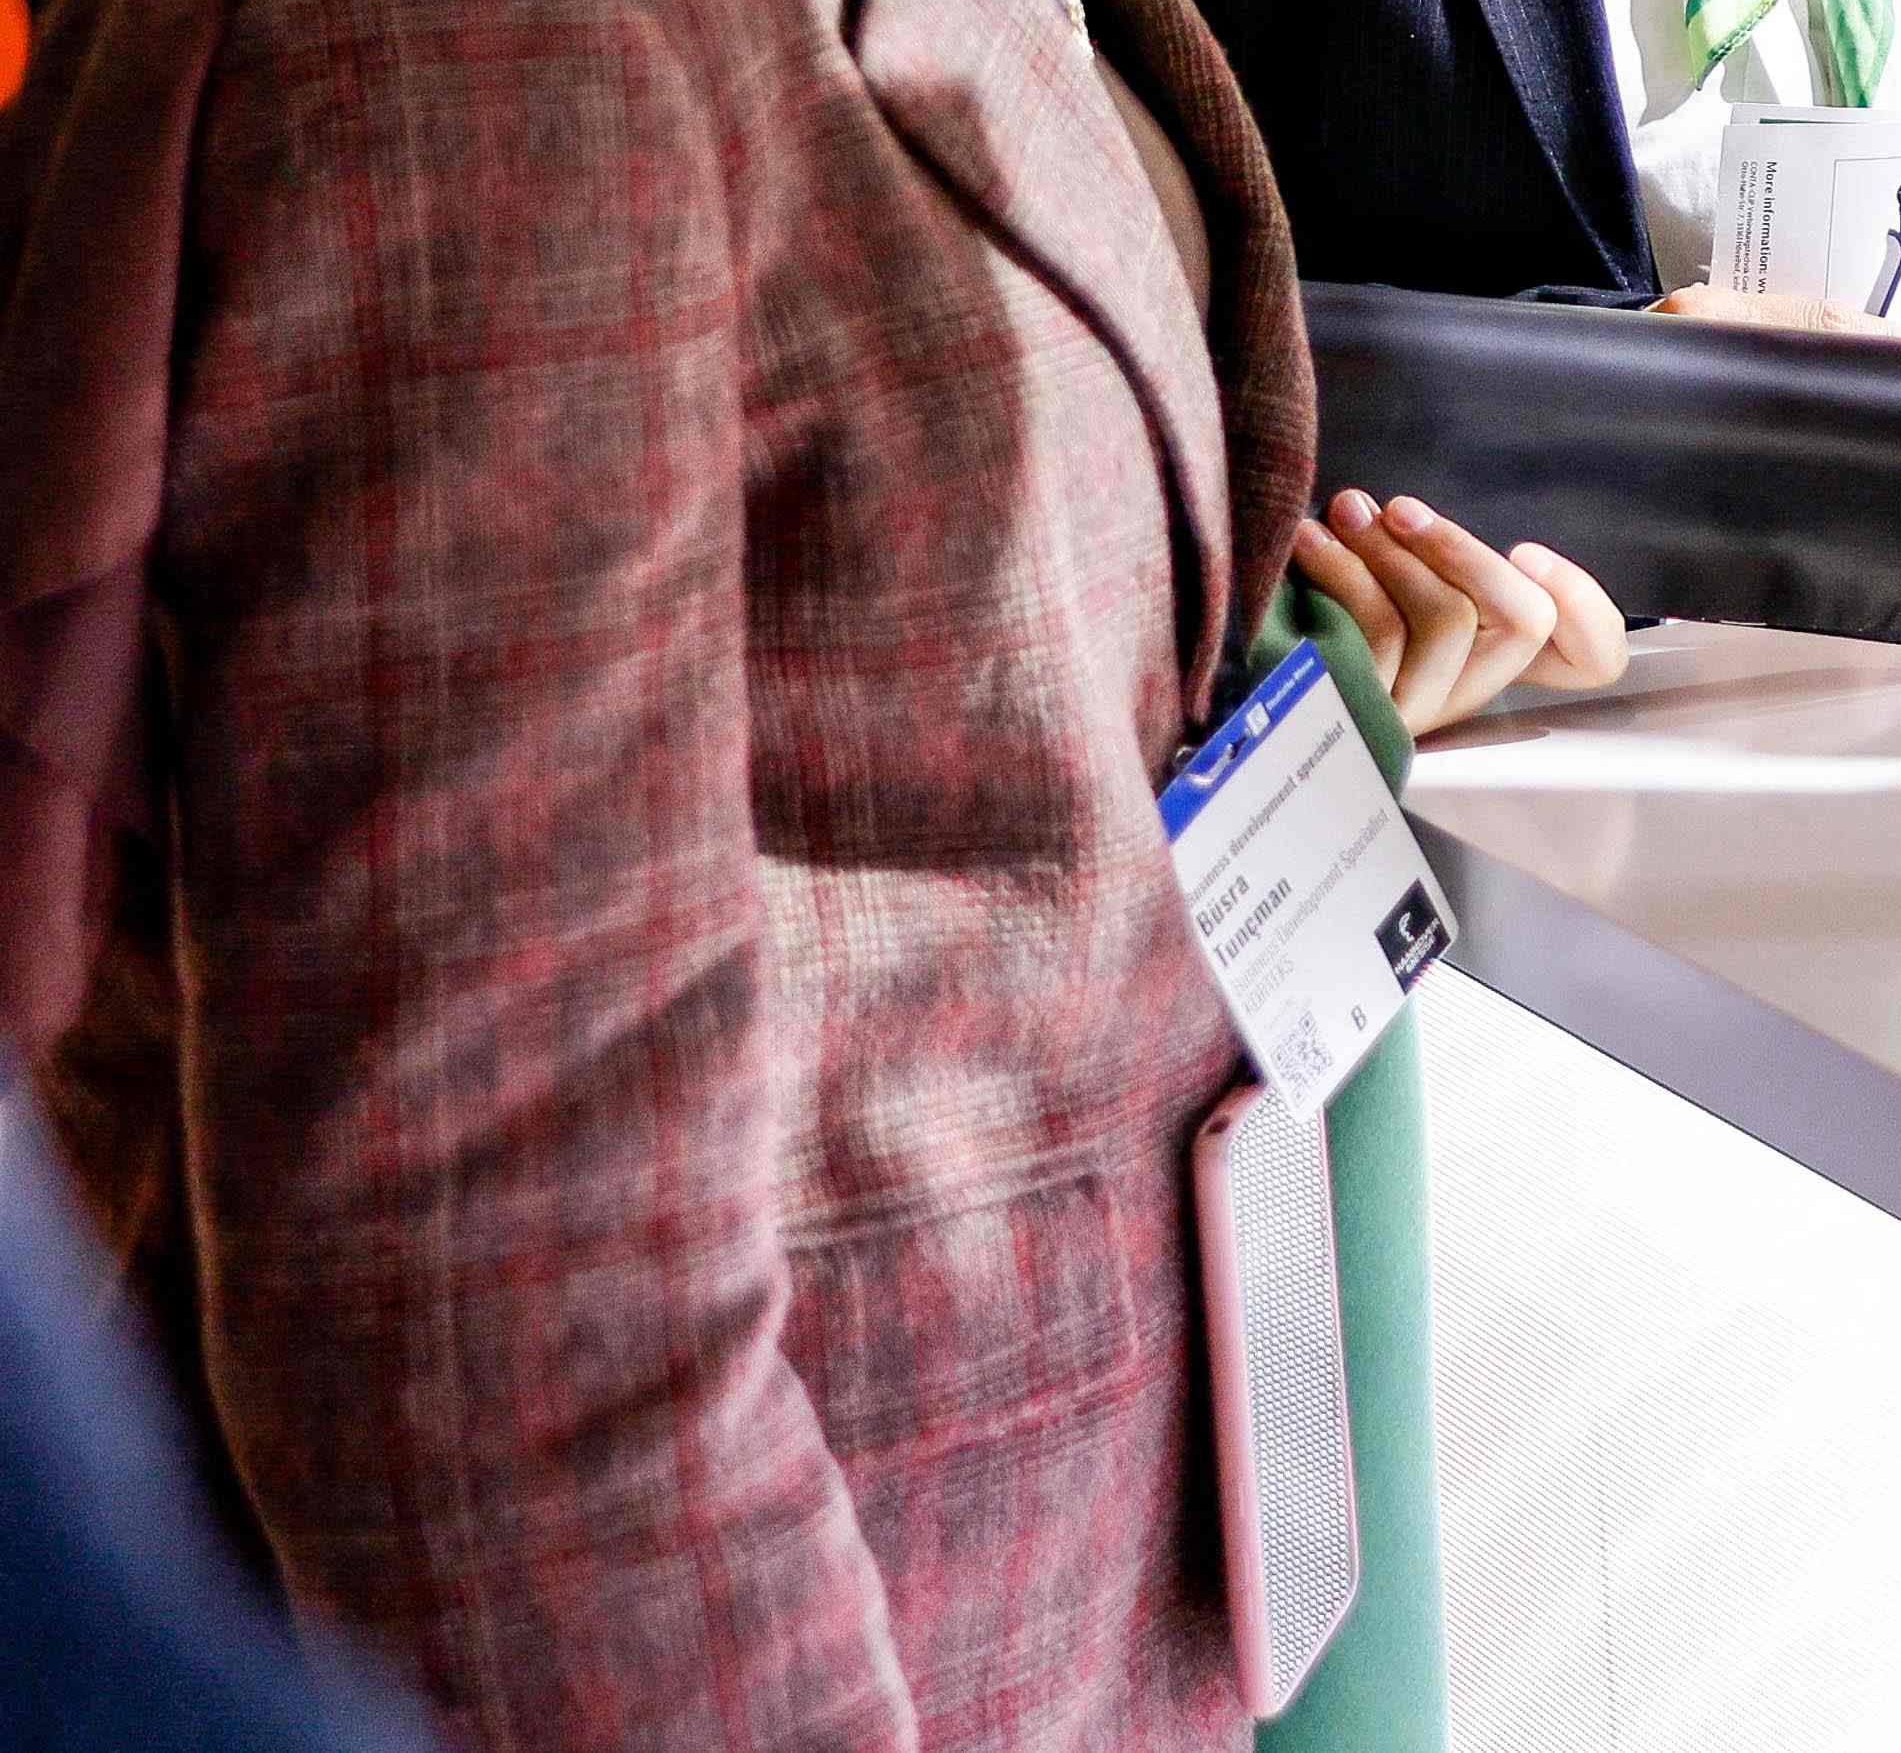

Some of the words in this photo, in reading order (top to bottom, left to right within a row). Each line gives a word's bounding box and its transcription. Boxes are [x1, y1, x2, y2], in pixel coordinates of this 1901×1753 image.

[1764, 161, 1776, 193] More
[1759, 197, 1774, 273] information:
[1295, 721, 1345, 781] specialist
[1212, 875, 1291, 967] Tunçman
[1350, 1004, 1369, 1030] B
